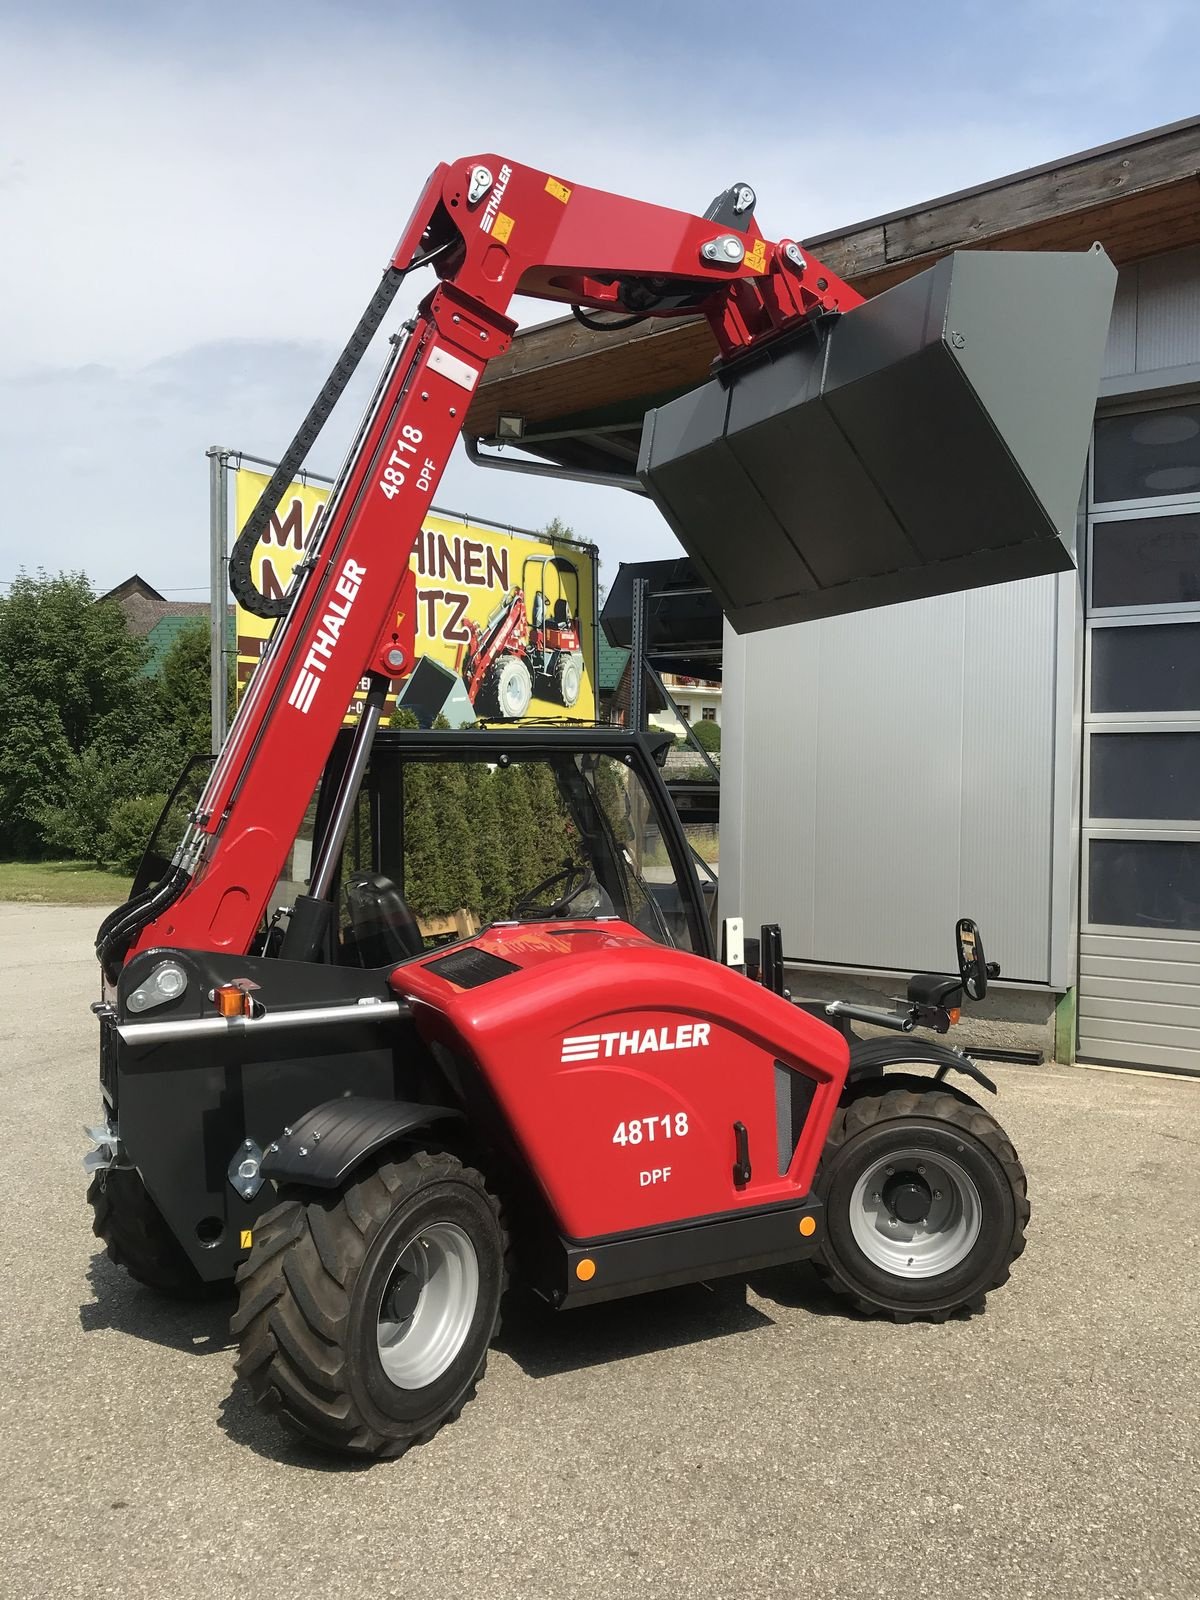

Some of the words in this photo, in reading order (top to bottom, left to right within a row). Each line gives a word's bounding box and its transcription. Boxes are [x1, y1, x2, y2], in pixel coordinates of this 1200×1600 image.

[379, 424, 423, 500] 48T18
[415, 457, 436, 492] DPF
[612, 1112, 689, 1147] 48T18
[639, 1166, 672, 1187] DPF
